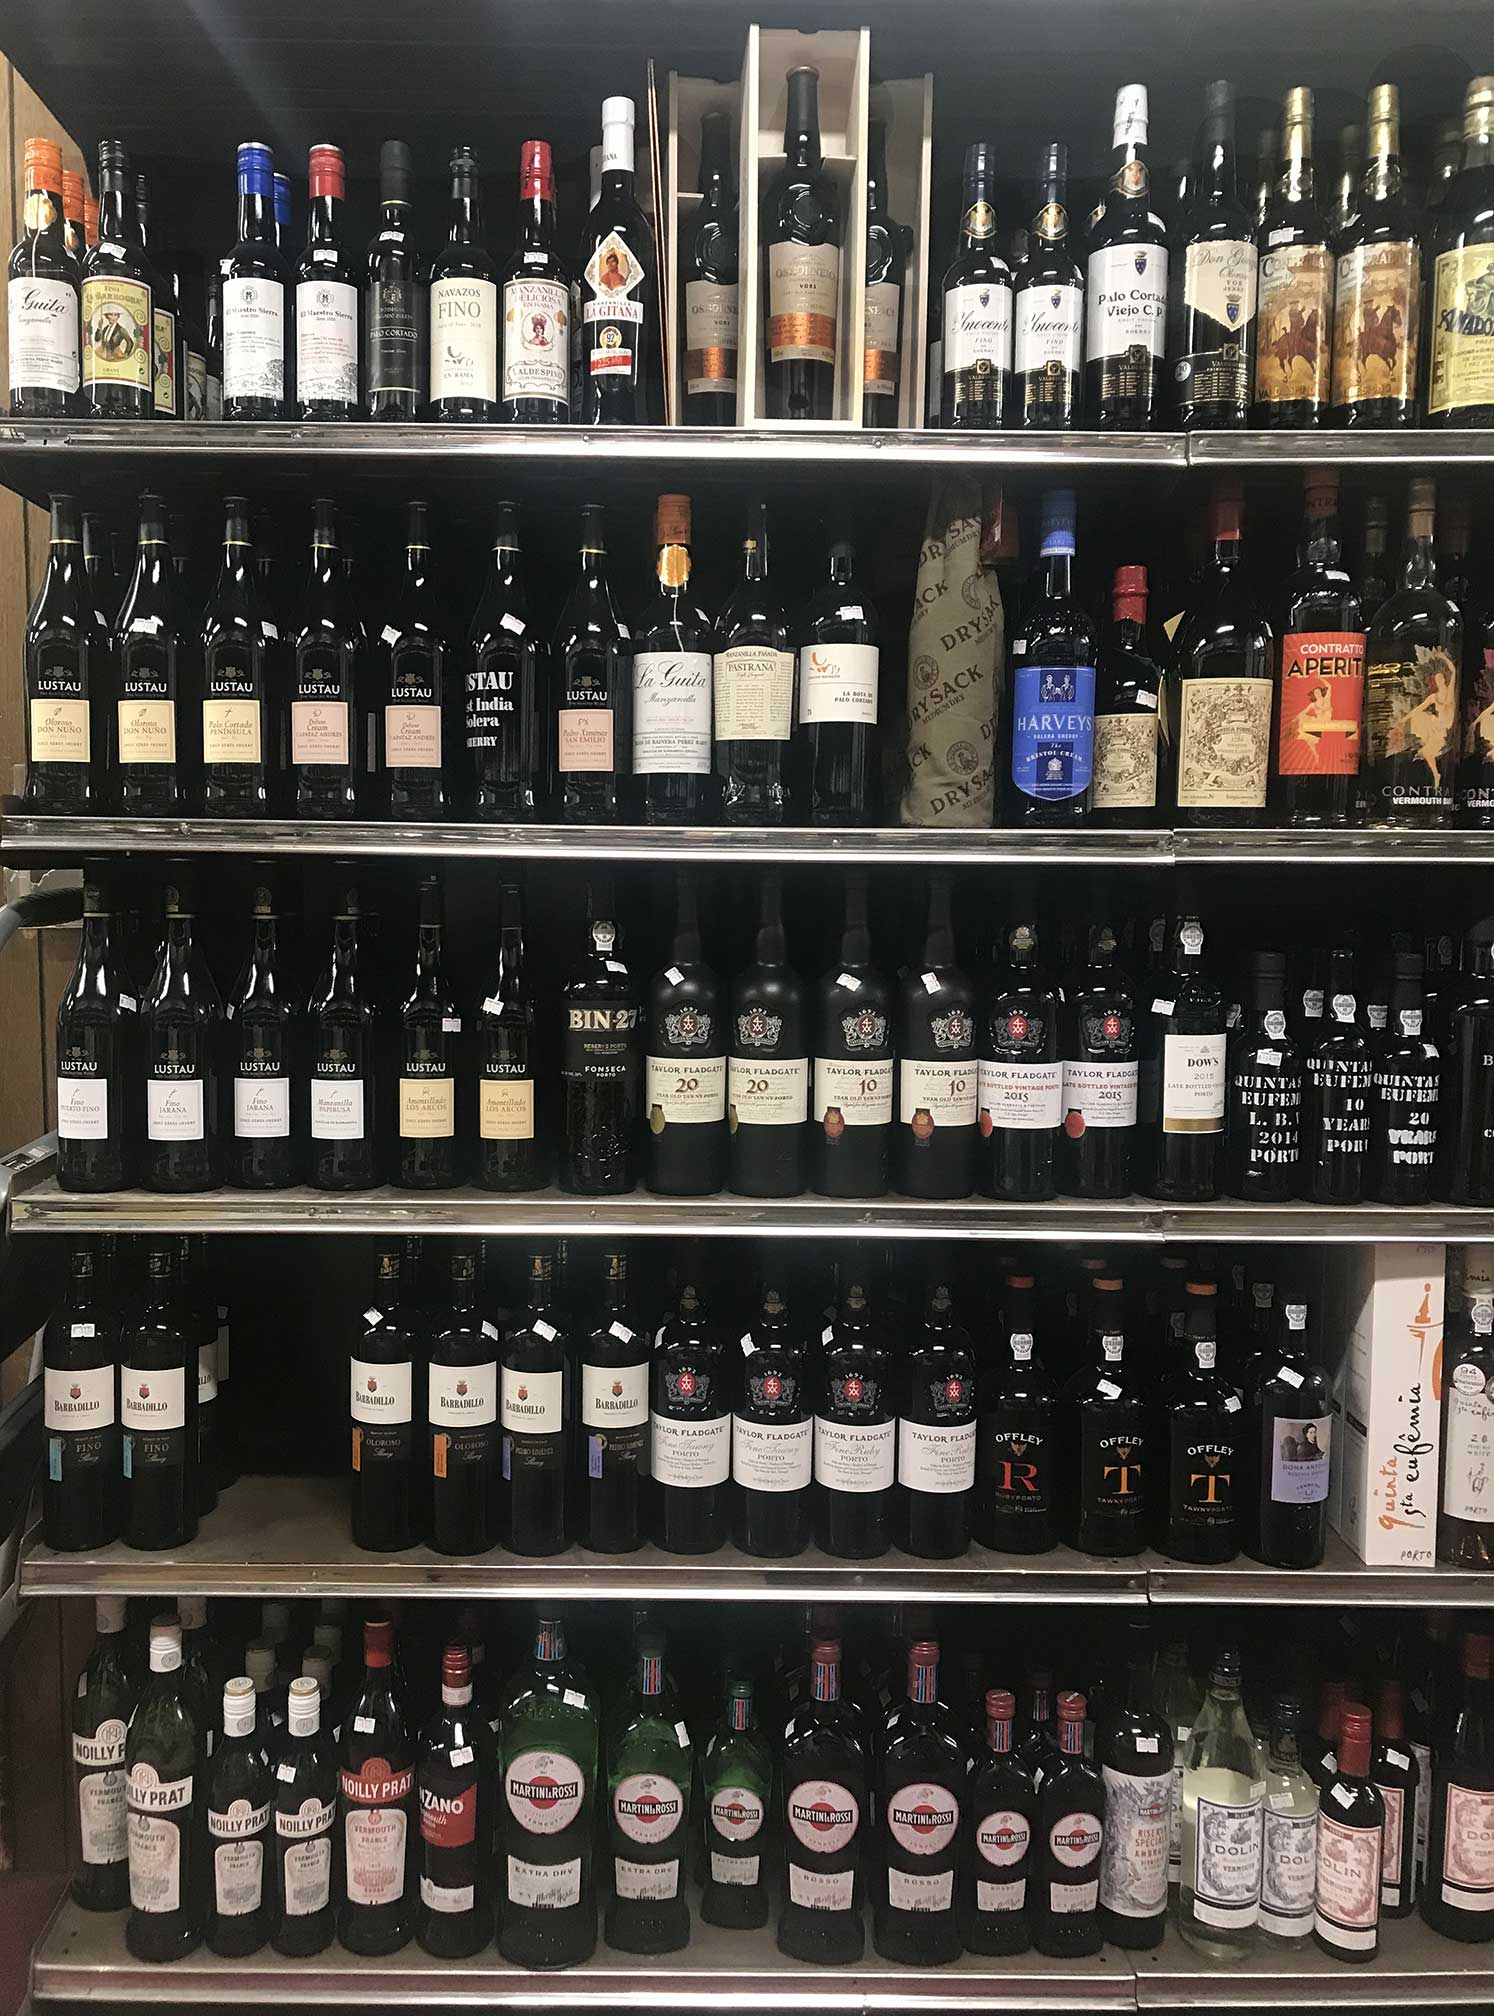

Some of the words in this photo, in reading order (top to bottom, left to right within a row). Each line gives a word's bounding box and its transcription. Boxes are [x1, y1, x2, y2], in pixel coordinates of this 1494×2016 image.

[438, 288, 481, 298] NAVAZOS
[21, 288, 66, 313] Guita
[258, 307, 278, 317] Sierra
[334, 310, 353, 320] Sierra
[438, 301, 481, 320] FINO
[599, 305, 638, 319] GITANA
[1107, 304, 1140, 317] Viejo
[606, 333, 615, 343] 92
[1300, 643, 1364, 655] CONTRATTO
[728, 663, 774, 672] PASTRANA
[635, 664, 654, 688] La
[38, 681, 81, 692] LUSTAU
[125, 682, 167, 693] LUSTAU
[210, 682, 253, 692] LUSTAU
[299, 684, 340, 695] LUSTAU
[930, 664, 984, 706] SACK
[391, 688, 432, 698] LUSTAU
[567, 691, 607, 701] LUSTAU
[476, 697, 514, 711] India
[209, 720, 222, 729] Palo
[224, 720, 253, 729] Cortado
[306, 724, 328, 732] Cream
[1018, 714, 1092, 731] HARVEYS
[38, 726, 54, 734] DON
[400, 727, 421, 735] Cream
[1026, 751, 1056, 762] BRISTOL
[1060, 750, 1082, 761] CREAM
[930, 782, 971, 815] DRY
[1393, 797, 1442, 805] VERMOUTH
[61, 1061, 97, 1072] LUSTAU
[154, 1064, 195, 1074] LUSTAU
[240, 1062, 280, 1072] LUSTAU
[317, 1063, 356, 1073] LUSTAU
[406, 1063, 446, 1072] LUSTAU
[486, 1064, 526, 1073] LUSTAU
[651, 1065, 681, 1074] TAYLOR
[684, 1065, 723, 1074] FLADGATE
[754, 1067, 799, 1075] FLADGATE
[827, 1067, 861, 1076] TAYLOR
[915, 1068, 950, 1077] TAYLOR
[980, 1069, 1008, 1079] TAYLOR
[1011, 1071, 1056, 1079] FLADGATE
[1068, 1069, 1102, 1078] TAYLOR
[675, 1078, 699, 1093] 20
[746, 1080, 769, 1094] 20
[859, 1080, 878, 1096] 10
[949, 1080, 966, 1096] 10
[986, 1083, 1013, 1091] BOTTLED
[408, 1097, 447, 1105] Amontillado
[487, 1098, 526, 1106] Amontillado
[1004, 1091, 1029, 1102] 2015
[1099, 1091, 1122, 1102] 2015
[165, 1099, 181, 1107] Fino
[421, 1103, 447, 1111] ARCOS
[1346, 1098, 1364, 1111] 10
[1409, 1112, 1429, 1125] 20
[1259, 1131, 1298, 1145] 2014
[1461, 1366, 1477, 1375] 94
[653, 1422, 679, 1437] TAYLOR
[681, 1425, 724, 1437] FLADGATE
[736, 1426, 764, 1440] TAYLOR
[766, 1429, 809, 1441] FLADGATE
[818, 1427, 848, 1441] TAYLOR
[850, 1431, 891, 1442] FLADGATE
[911, 1431, 948, 1443] TAYLOR
[995, 1432, 1043, 1446] OFFLEY
[1100, 1436, 1144, 1448] OFFLEY
[77, 1442, 102, 1452] FINO
[144, 1443, 169, 1452] FINO
[454, 1440, 489, 1450] OLOROSO
[672, 1450, 699, 1458] PORTO
[1187, 1445, 1234, 1457] OFFLEY
[941, 1455, 966, 1463] PORTO
[1000, 1460, 1040, 1491] R
[1103, 1464, 1141, 1494] T
[1190, 1474, 1230, 1503] T
[1379, 1456, 1425, 1529] quinta
[1401, 1551, 1431, 1560] PORTO
[76, 1743, 115, 1760] NOILLY
[342, 1775, 380, 1798] NOILLY
[382, 1774, 412, 1796] PRAT
[150, 1787, 185, 1805] PRAT
[210, 1814, 242, 1832] NOILLY
[245, 1810, 269, 1827] PRAT
[279, 1817, 314, 1832] NOILLY
[316, 1806, 336, 1826] PRAT
[354, 1825, 396, 1834] VERMOUTH
[1215, 1842, 1258, 1855] DOLIN
[294, 1850, 325, 1861] VERMOUTH
[300, 1859, 320, 1868] FRANCE
[514, 1866, 548, 1877] EXTRA
[553, 1867, 573, 1877] DRY
[620, 1866, 652, 1874] EXTRA
[803, 1875, 839, 1885] ROSSO
[903, 1878, 940, 1886] ROSSO
